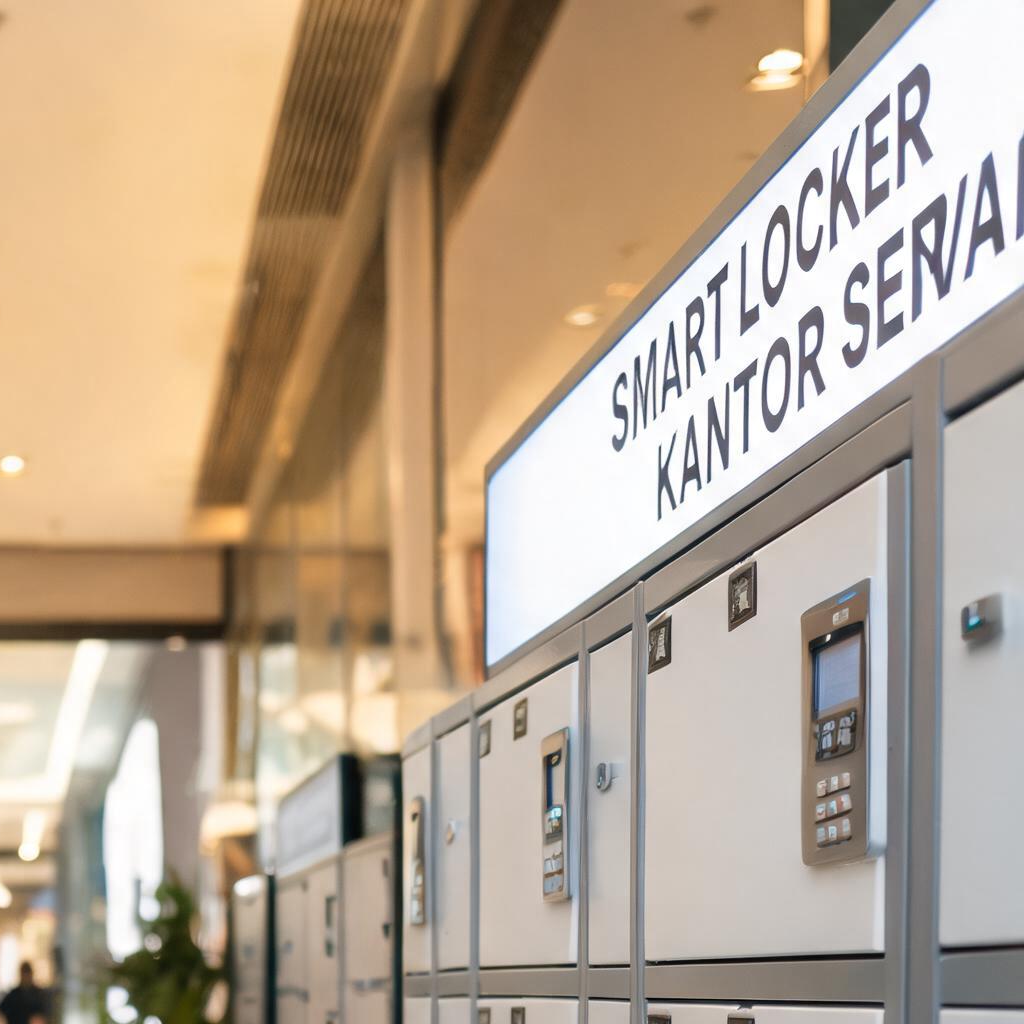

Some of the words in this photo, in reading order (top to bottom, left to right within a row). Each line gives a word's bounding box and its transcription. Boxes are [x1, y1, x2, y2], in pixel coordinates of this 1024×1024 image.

[611, 261, 729, 453] SMART
[739, 63, 934, 337] LOCKER
[657, 305, 826, 521] KANTOR
